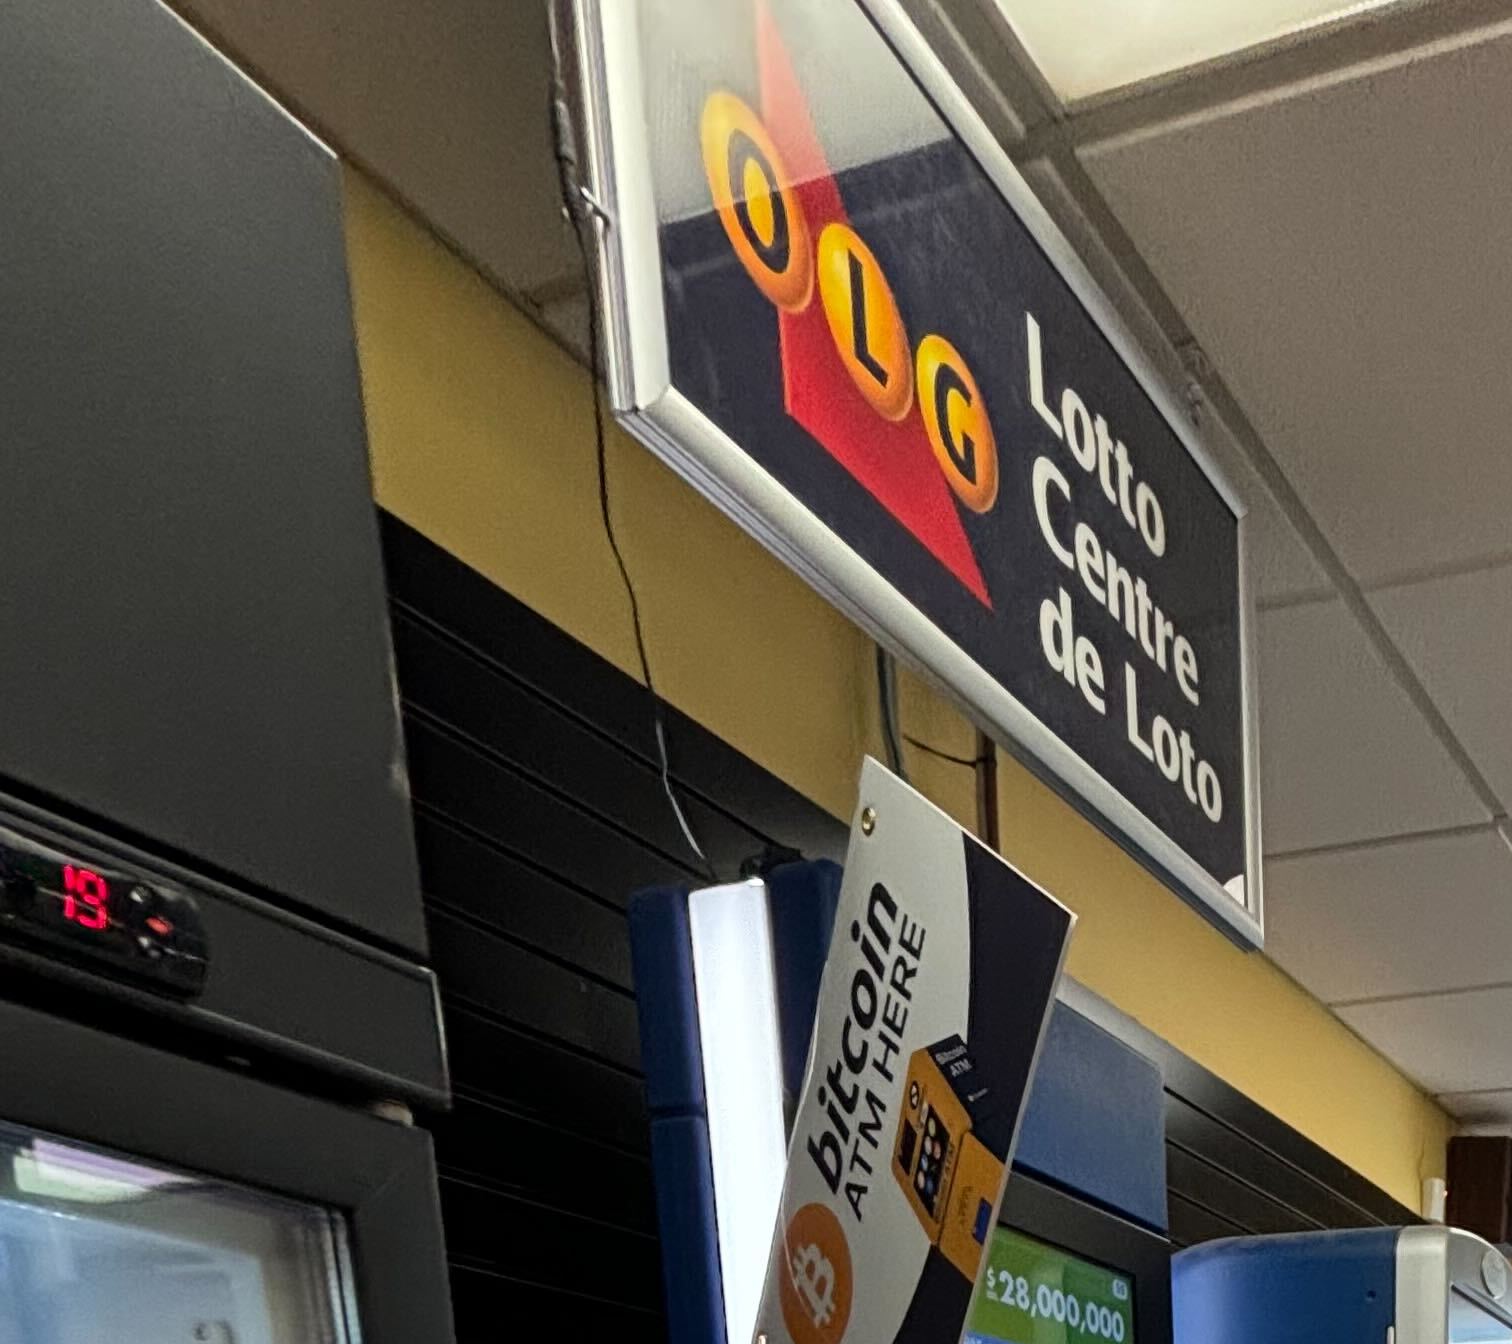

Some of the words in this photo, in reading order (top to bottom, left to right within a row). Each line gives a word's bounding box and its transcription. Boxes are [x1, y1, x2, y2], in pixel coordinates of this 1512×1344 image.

[728, 129, 976, 486] OLG
[1026, 312, 1166, 558] Lotto
[1030, 456, 1199, 708] Centre
[1038, 590, 1106, 715] de
[1126, 667, 1222, 824] Loto
[808, 881, 898, 1195] bitcoin
[842, 1090, 892, 1222] ATM
[875, 913, 927, 1089] HERE
